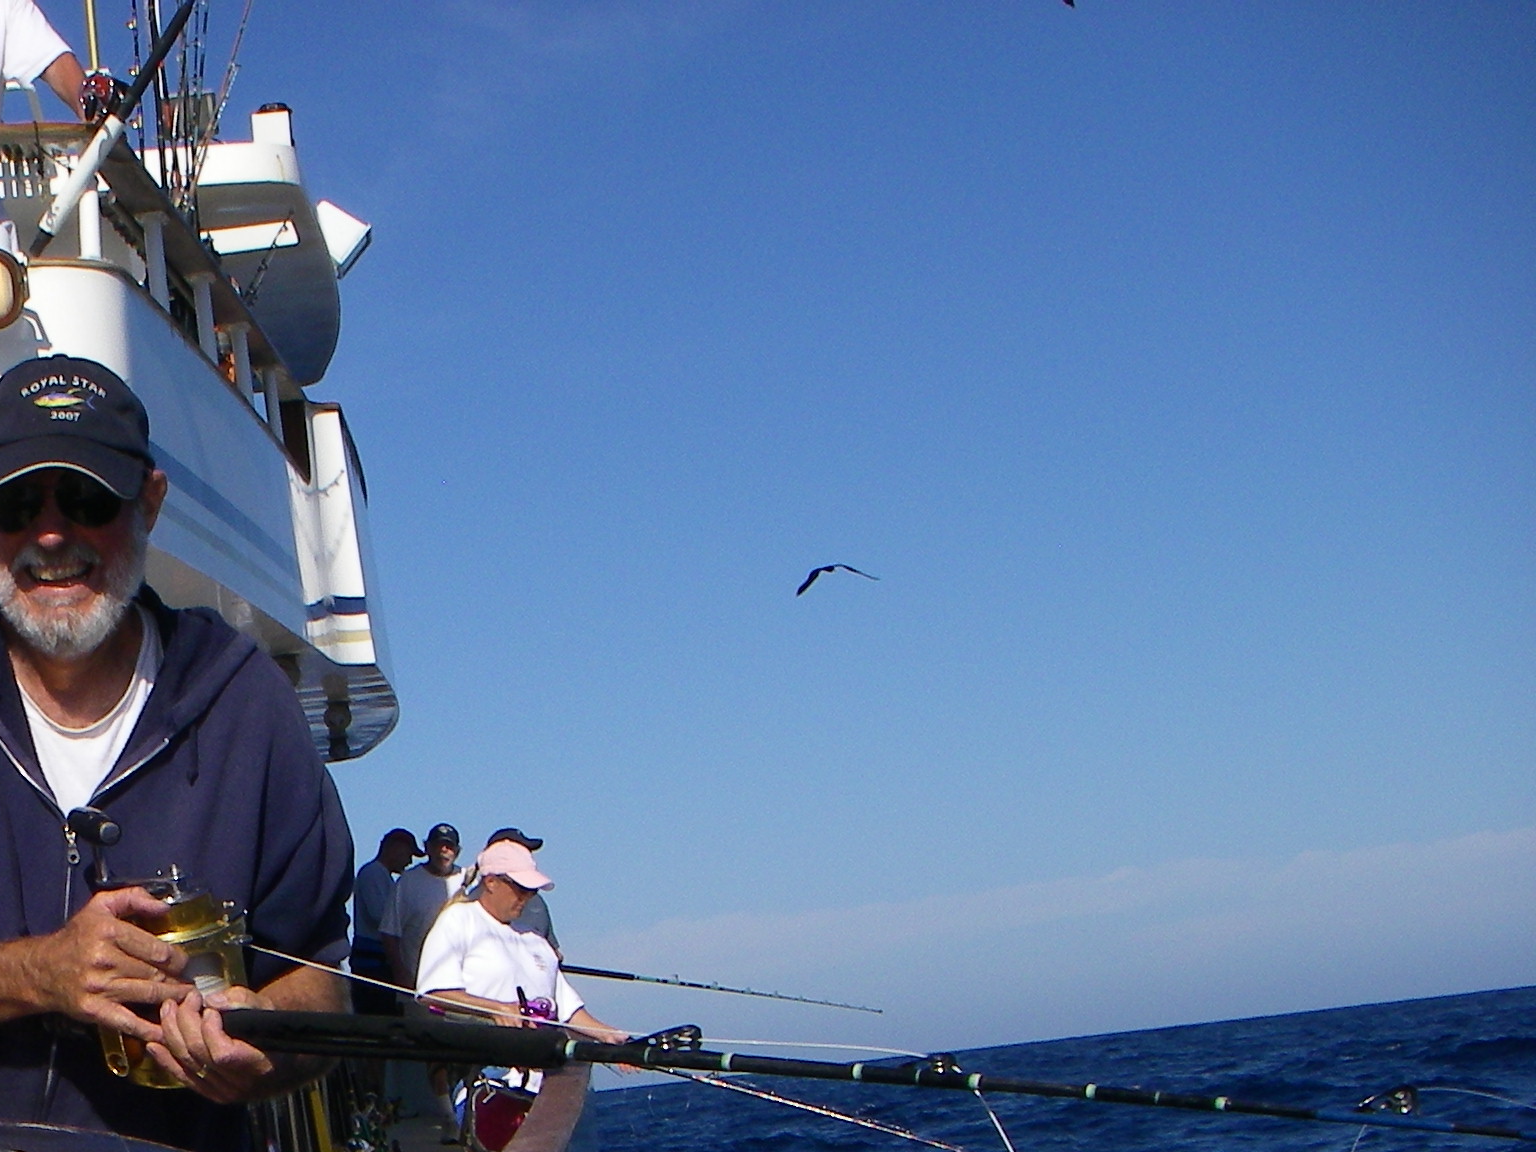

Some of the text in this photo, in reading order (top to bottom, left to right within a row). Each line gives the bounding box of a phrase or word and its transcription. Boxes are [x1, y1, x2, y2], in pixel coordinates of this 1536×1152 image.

[20, 374, 107, 399] ROYAL STAR
[49, 410, 81, 422] 2007
